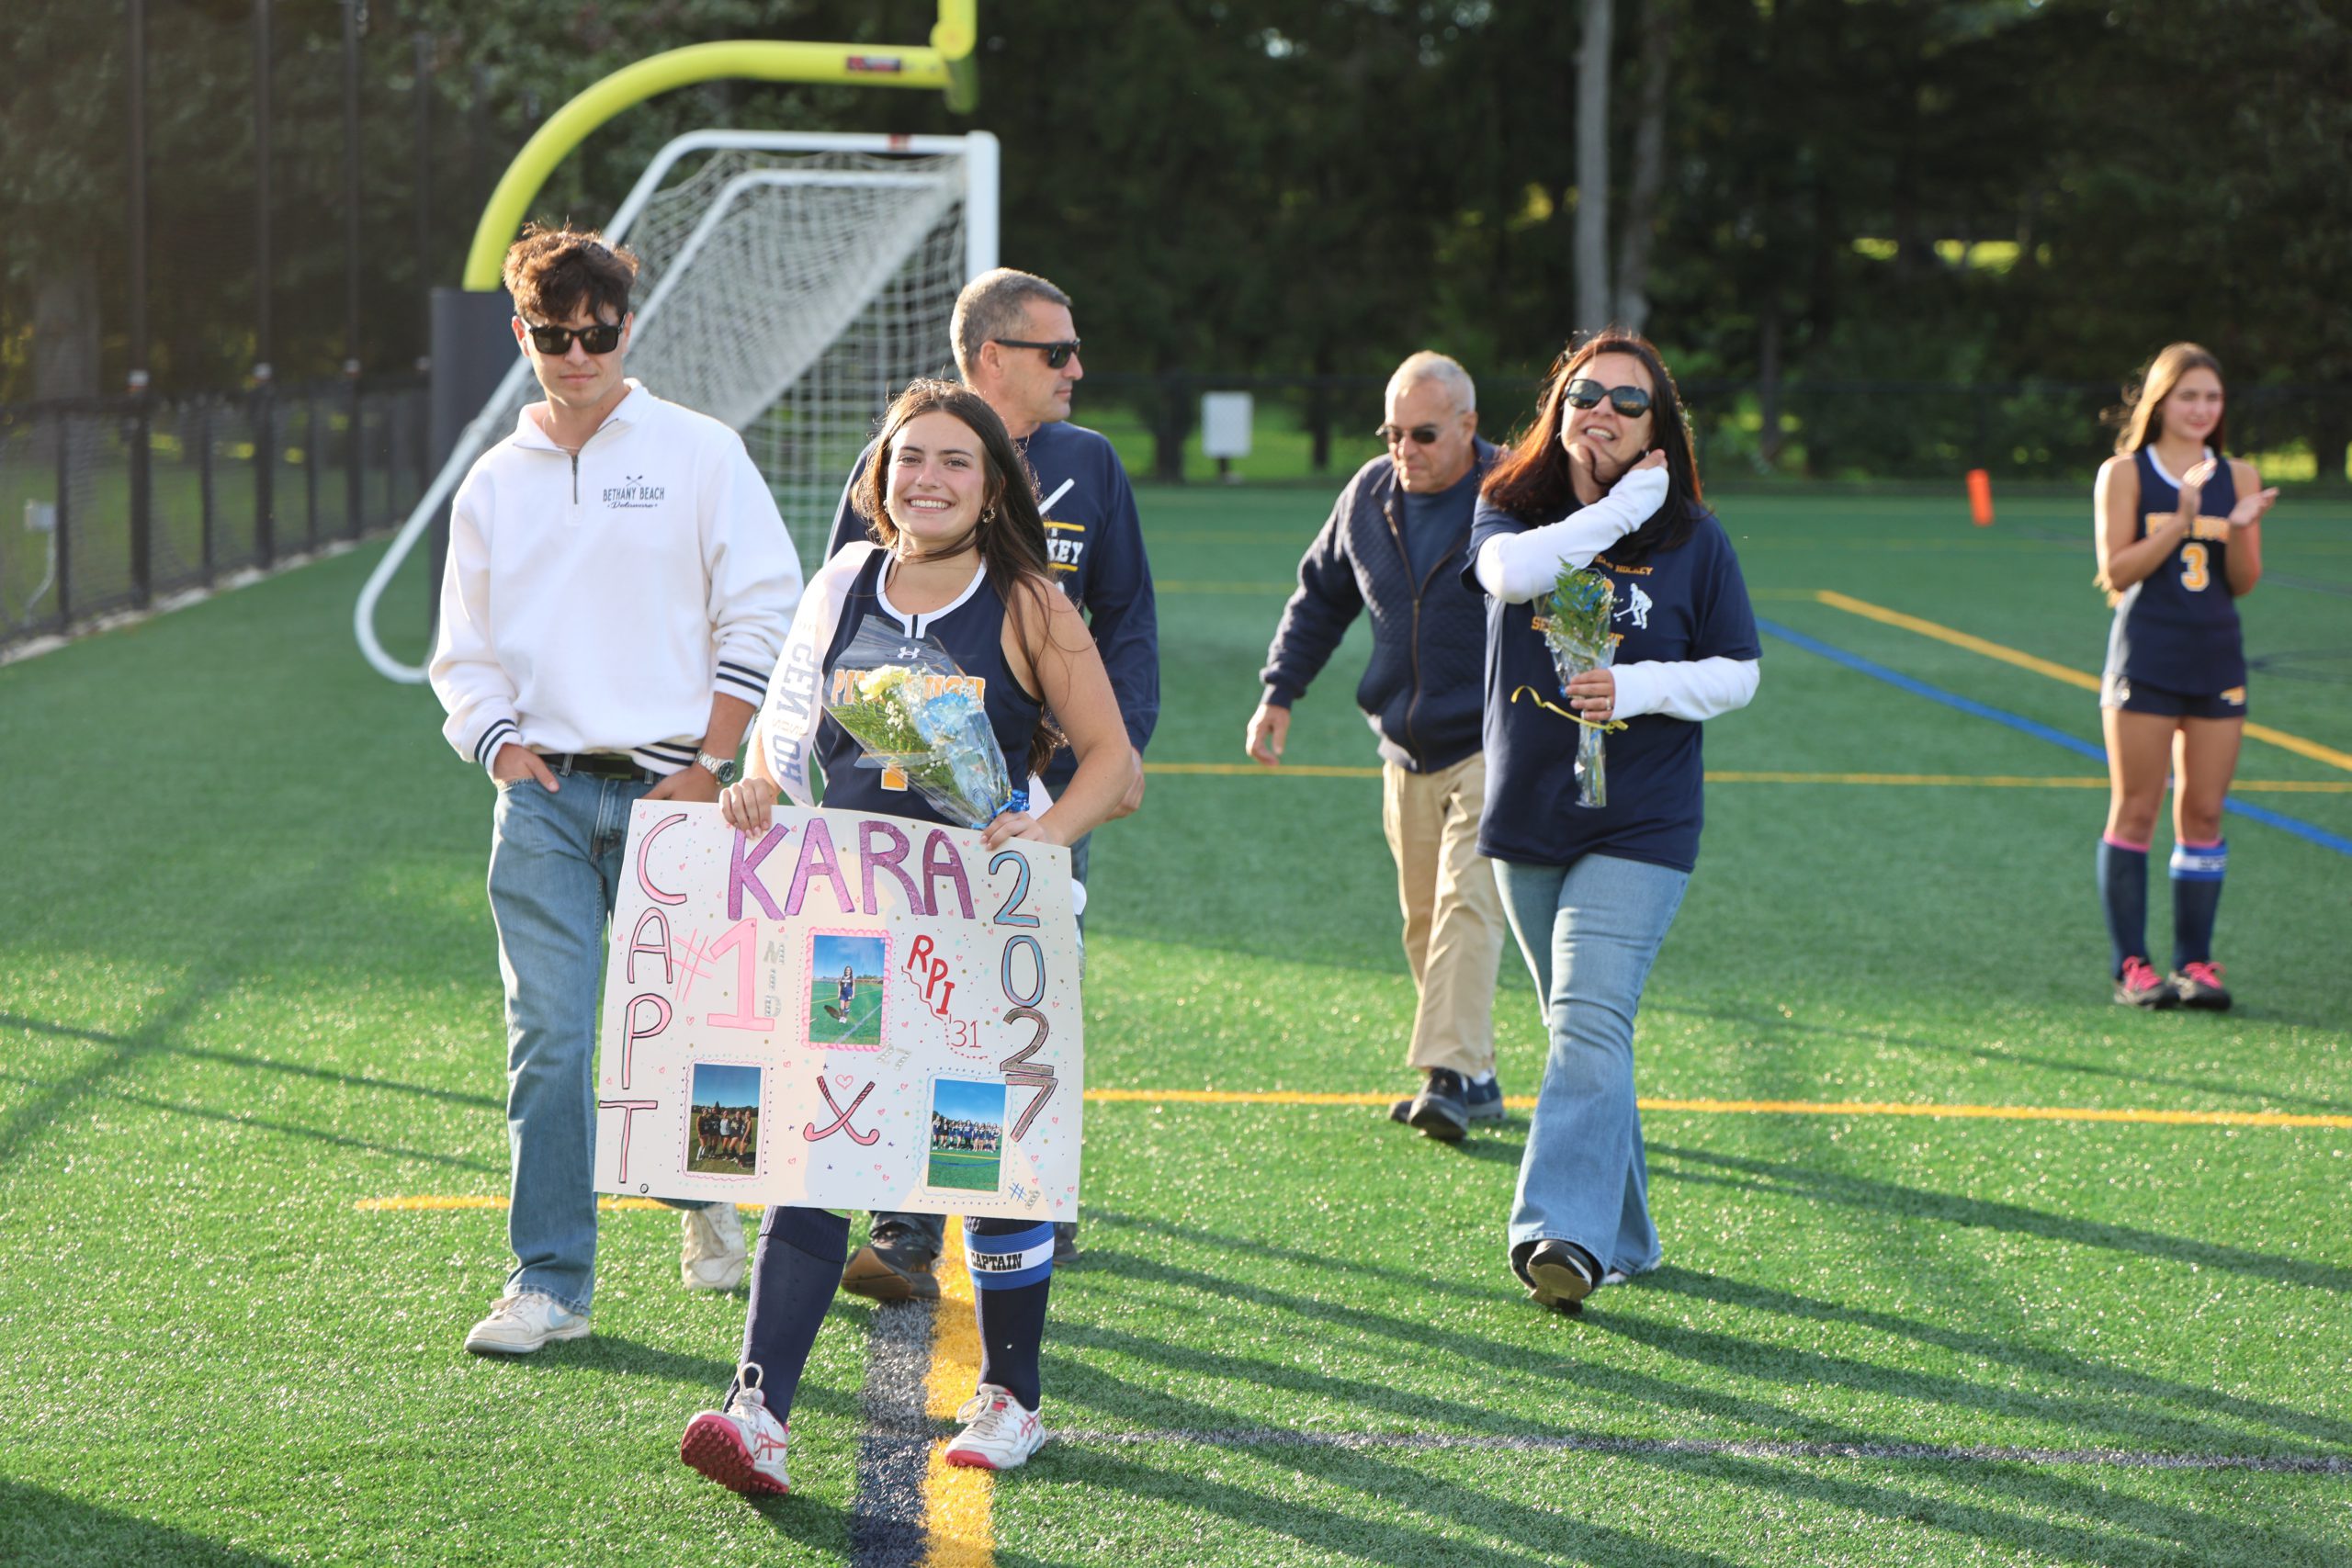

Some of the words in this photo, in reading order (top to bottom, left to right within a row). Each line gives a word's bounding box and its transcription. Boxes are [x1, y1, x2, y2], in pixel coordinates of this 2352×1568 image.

[603, 487, 636, 502] BETHANY
[639, 487, 664, 501] BEACH
[2181, 542, 2210, 592] 3
[727, 818, 976, 921] KARA
[907, 934, 956, 1015] RPI
[989, 850, 1058, 1143] 2027
[970, 1250, 1023, 1271] CAPTAIN
